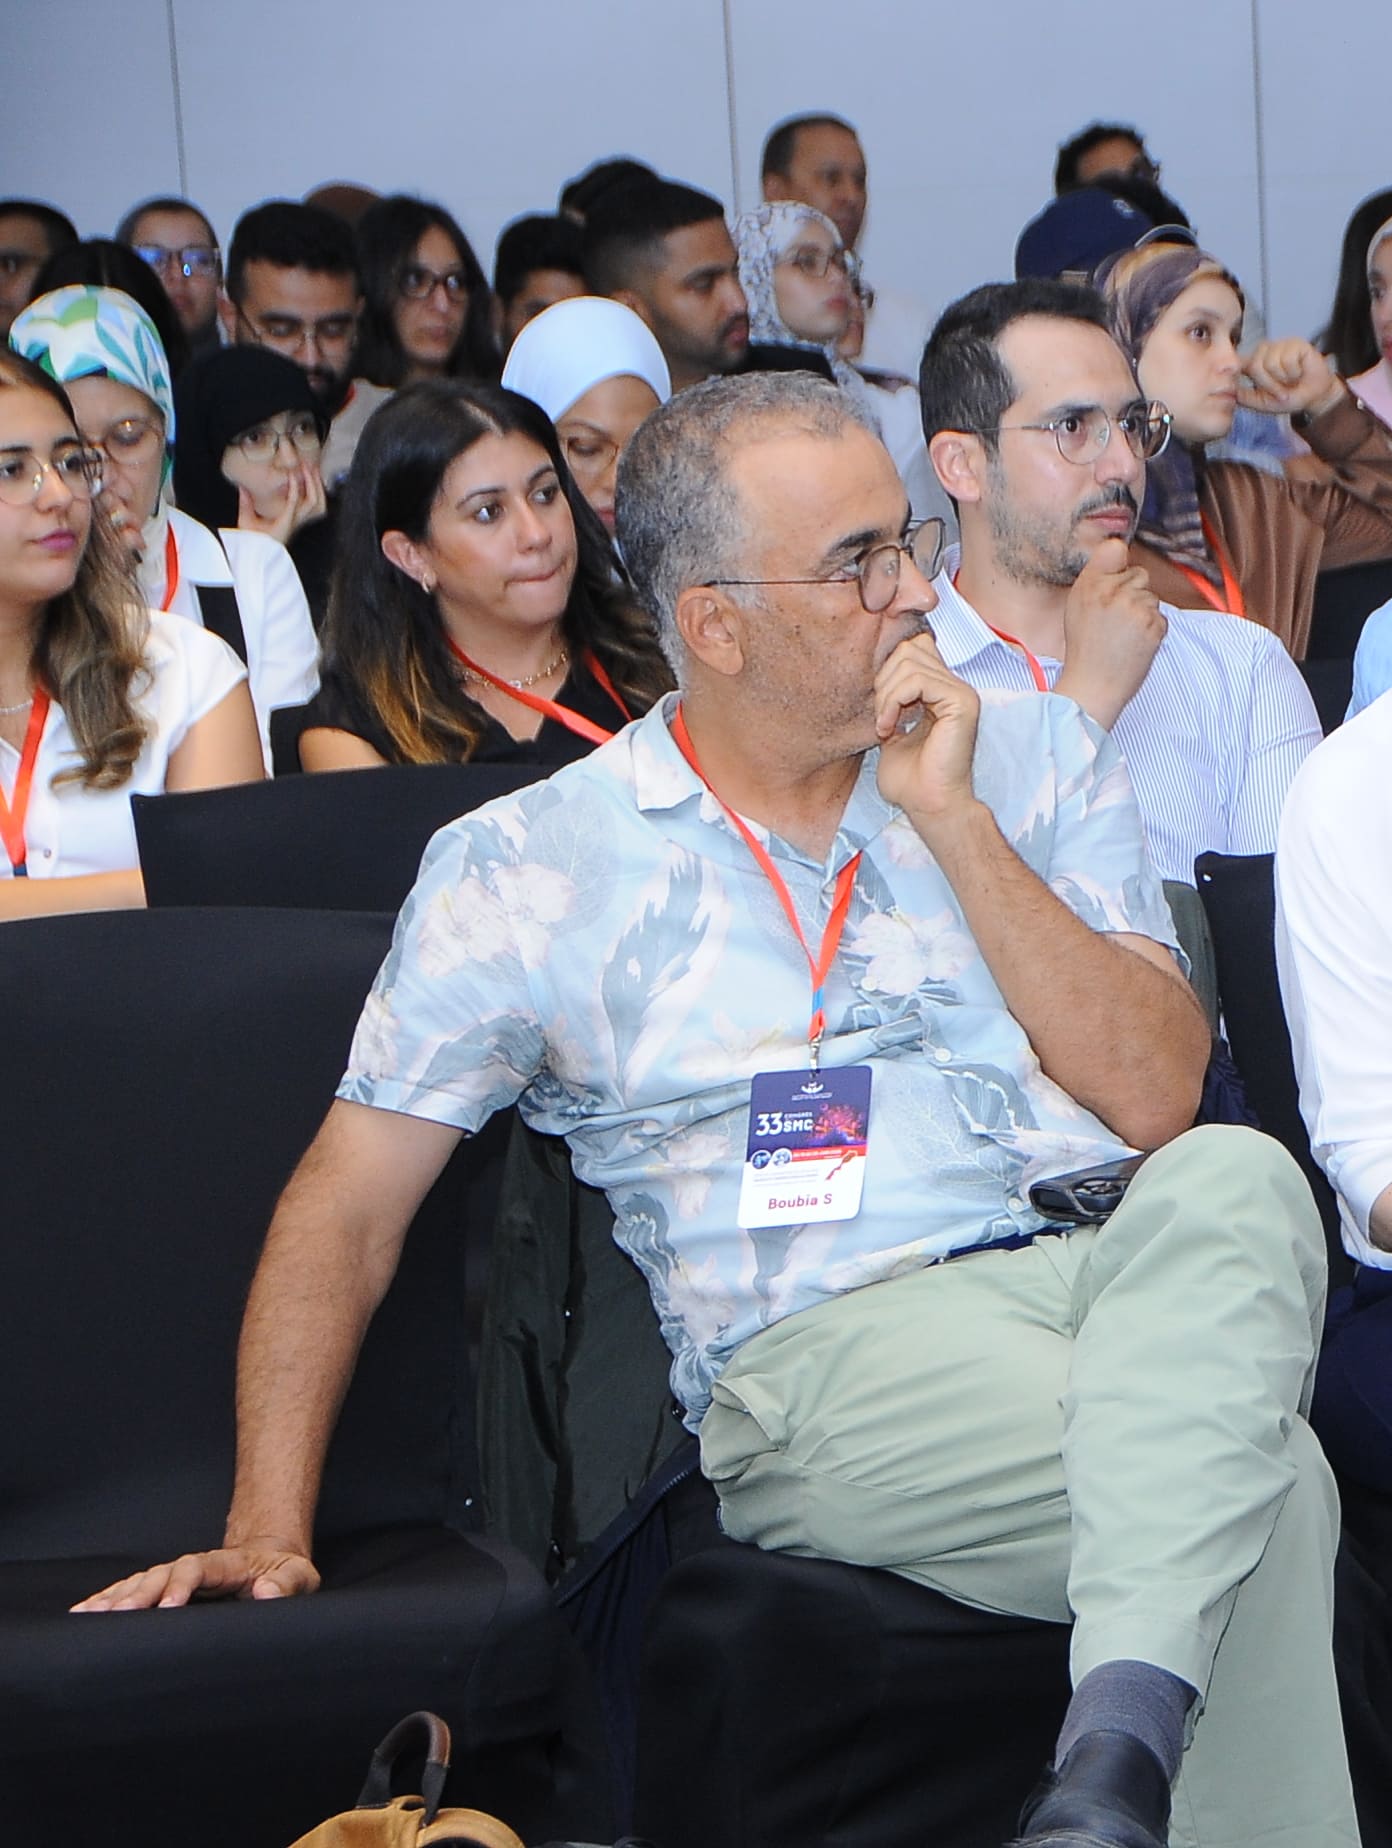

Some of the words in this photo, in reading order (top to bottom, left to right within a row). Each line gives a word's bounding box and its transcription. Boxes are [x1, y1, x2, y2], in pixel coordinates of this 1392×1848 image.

[755, 1111, 783, 1137] 33
[783, 1119, 814, 1133] SMC
[768, 1193, 818, 1210] Boubia
[823, 1192, 833, 1205] S
